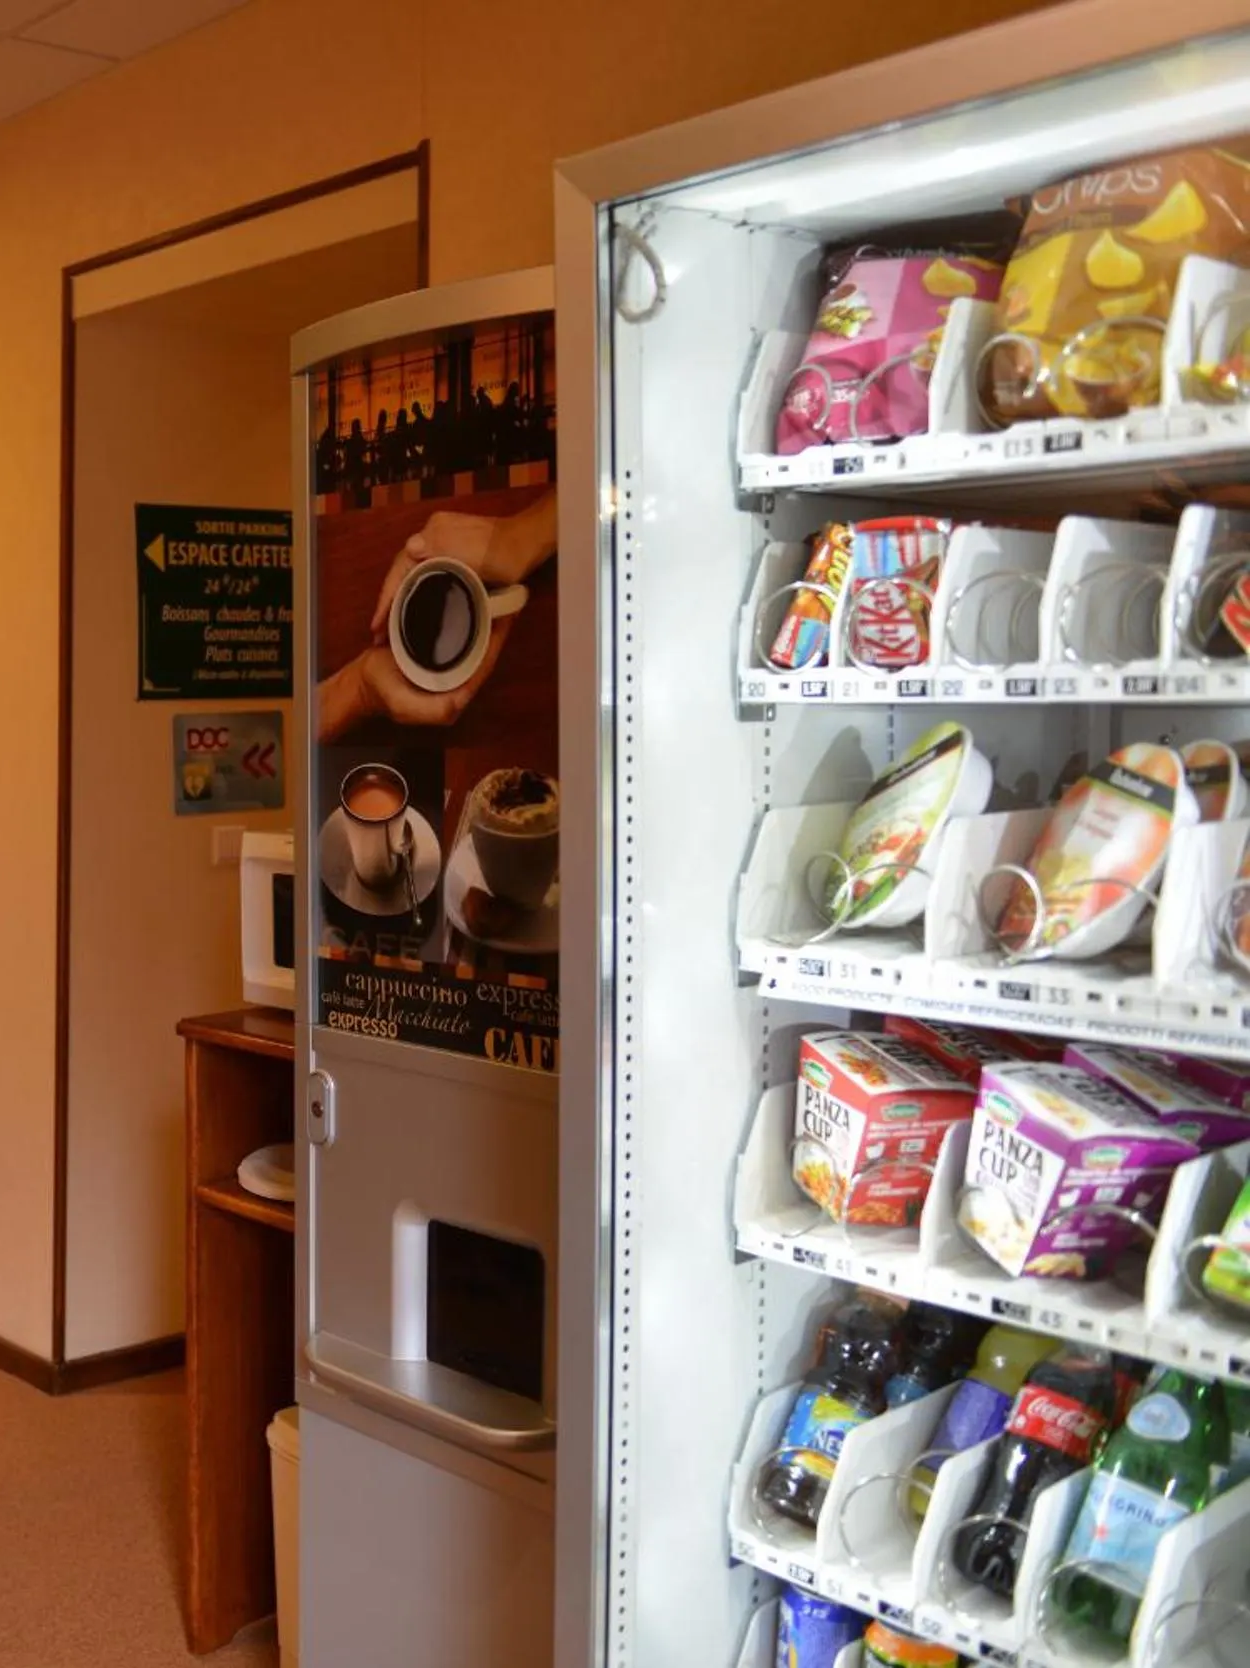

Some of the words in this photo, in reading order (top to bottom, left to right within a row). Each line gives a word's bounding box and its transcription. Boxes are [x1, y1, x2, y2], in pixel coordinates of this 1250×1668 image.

[168, 541, 228, 566] ESPACE
[231, 544, 292, 568] CAFETE
[345, 972, 469, 1007] cappuccino
[328, 1010, 398, 1038] expresso
[804, 1085, 851, 1130] PANZA
[803, 1110, 832, 1142] CUP
[978, 1146, 1018, 1185] CUP
[982, 1120, 1044, 1177] PANZA
